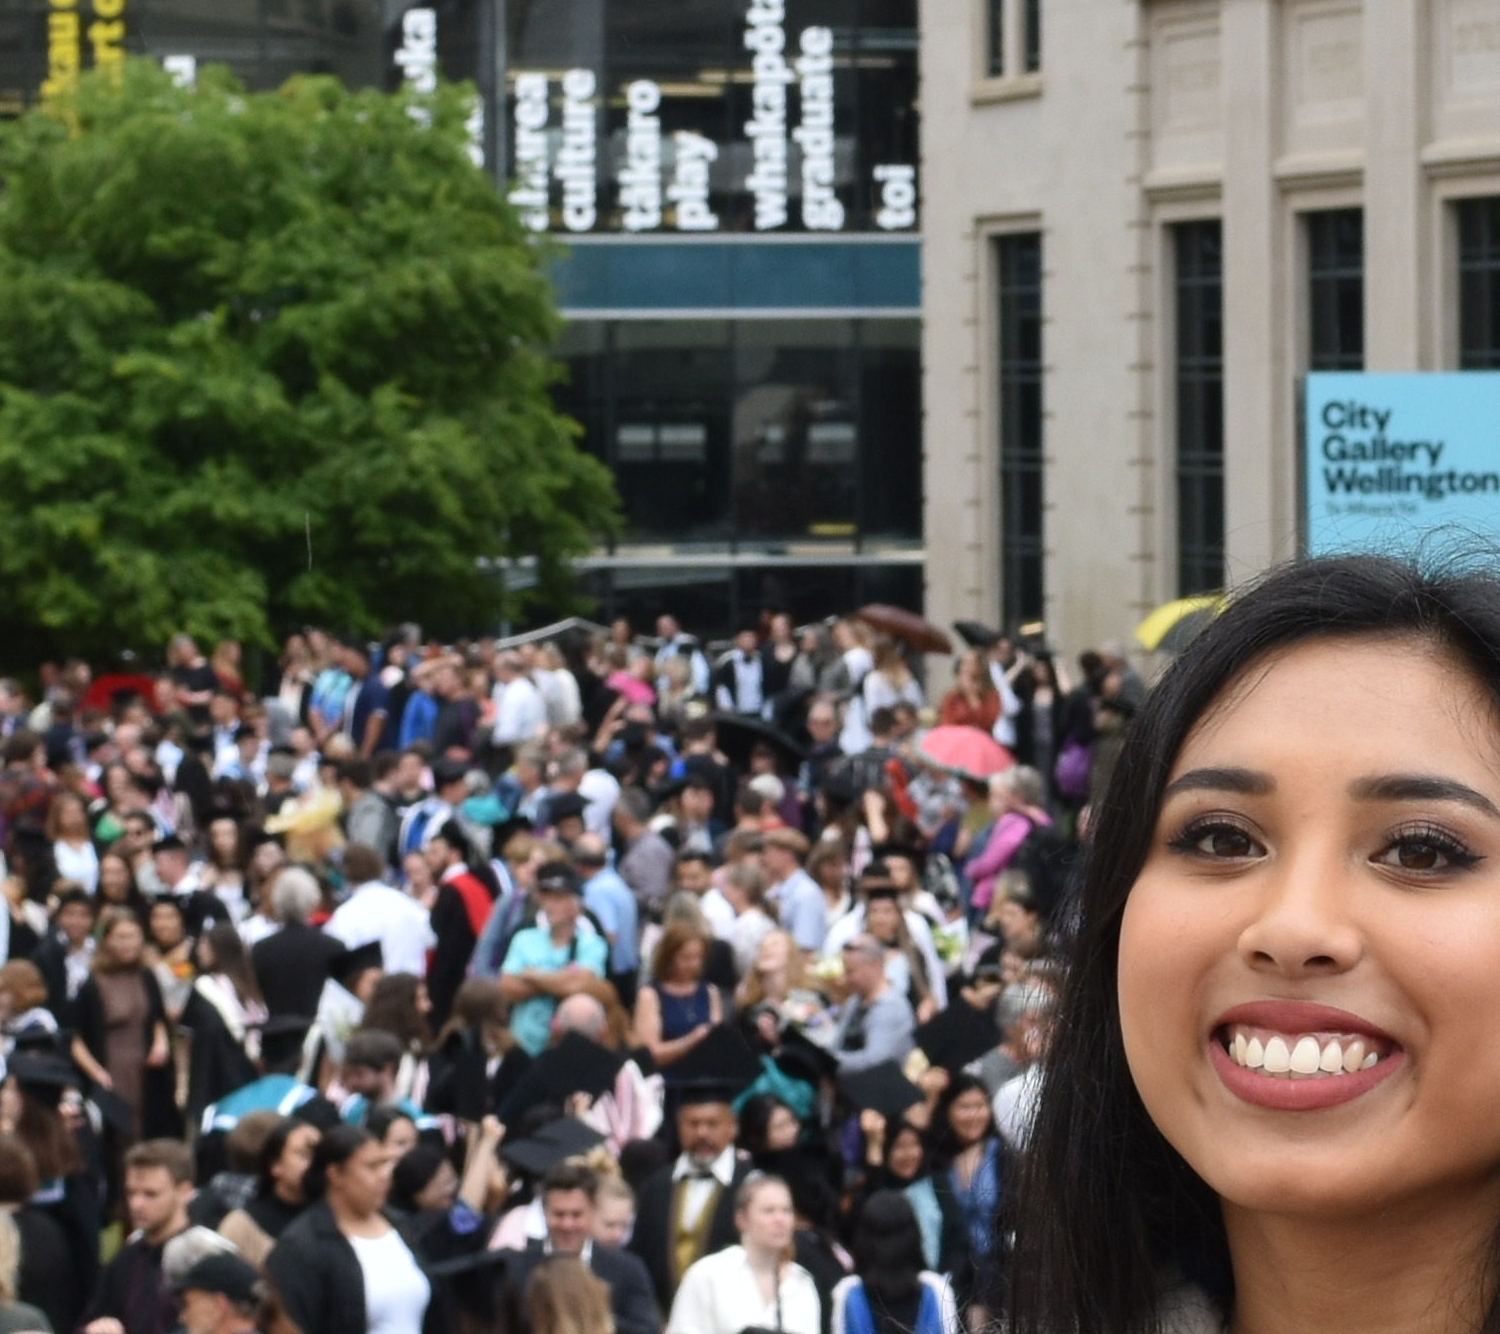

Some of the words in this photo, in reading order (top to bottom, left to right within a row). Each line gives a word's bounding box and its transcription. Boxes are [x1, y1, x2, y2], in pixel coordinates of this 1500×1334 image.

[554, 68, 596, 230] culture
[617, 79, 661, 230] tākaro
[792, 25, 844, 230] graduate
[665, 130, 718, 230] play
[873, 165, 915, 229] toi
[1320, 400, 1392, 432] City
[1322, 434, 1444, 467] Gallery
[1323, 466, 1500, 501] Wellington
